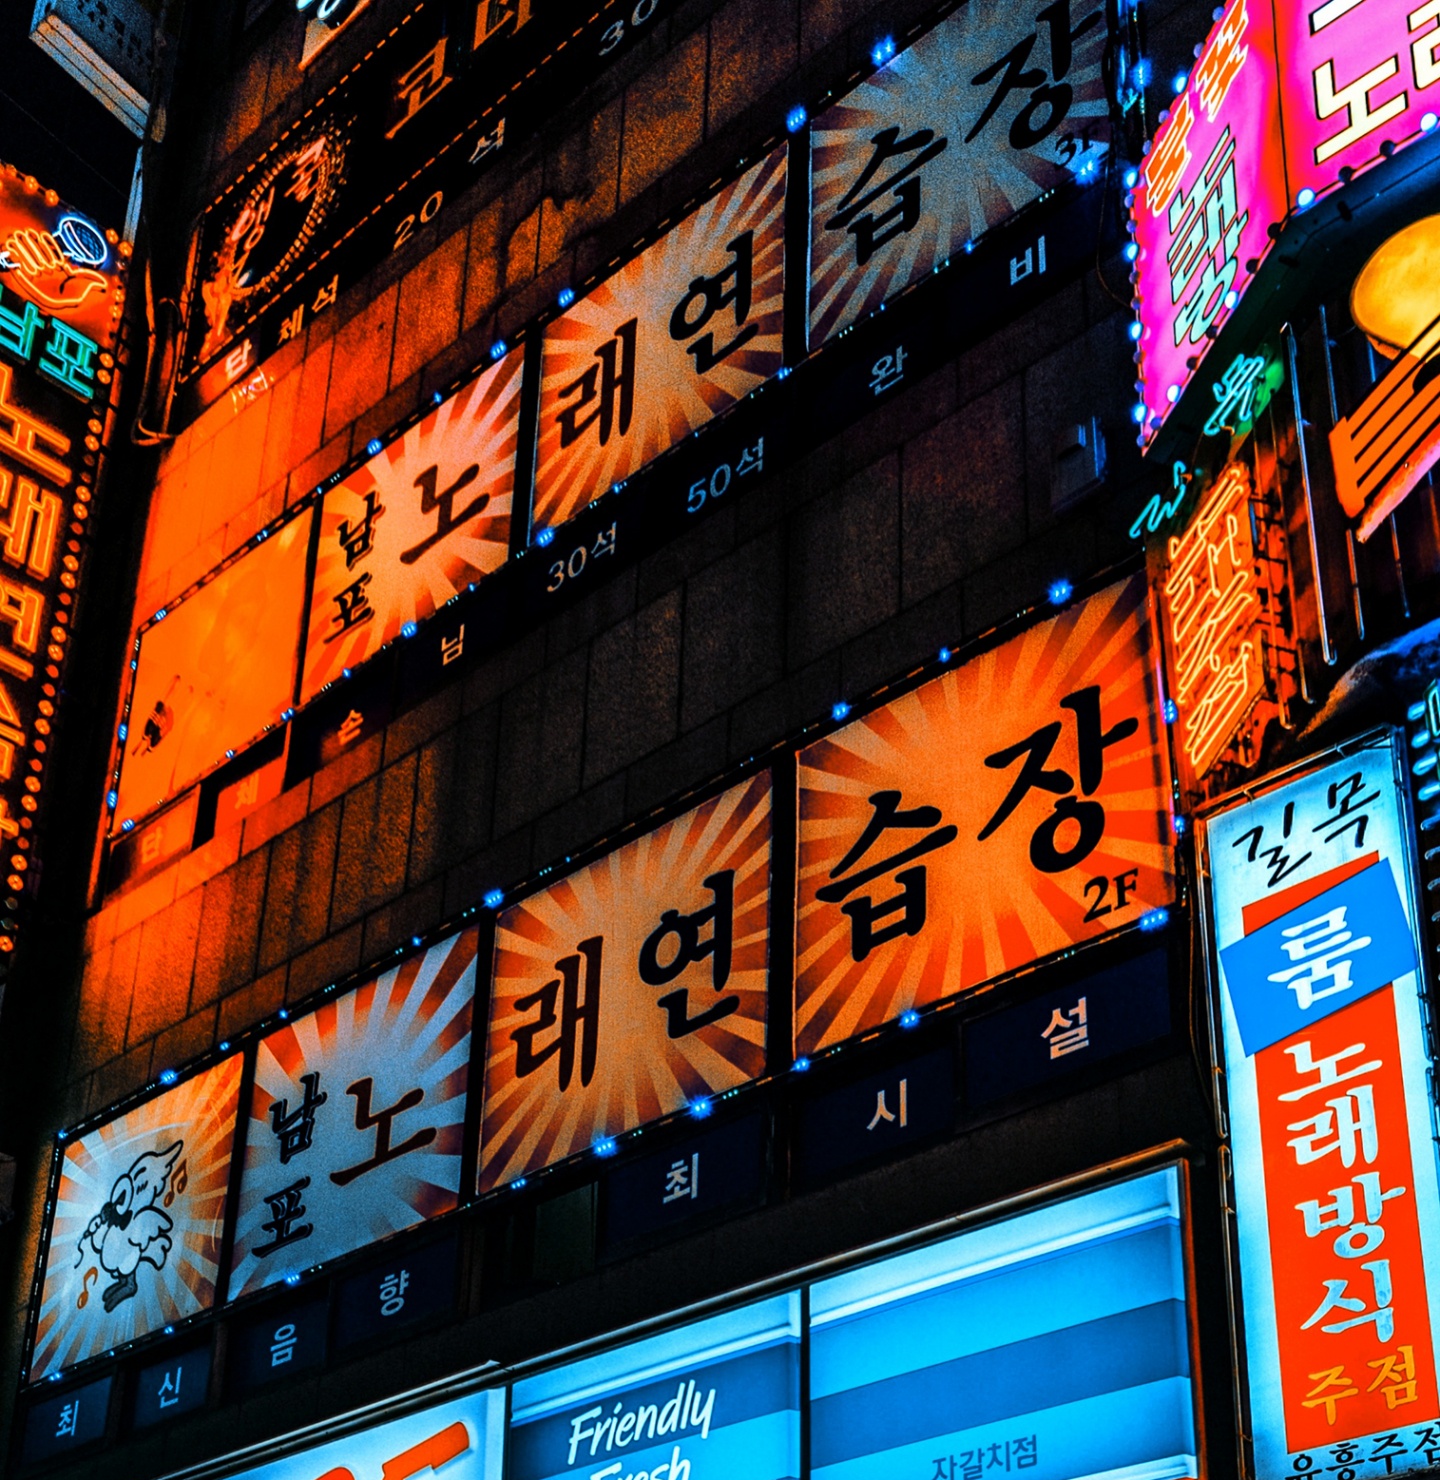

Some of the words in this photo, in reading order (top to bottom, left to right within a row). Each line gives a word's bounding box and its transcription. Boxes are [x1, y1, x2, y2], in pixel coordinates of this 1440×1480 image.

[1168, 124, 1249, 347] 노래방
[687, 436, 766, 514] 50석
[324, 490, 386, 645] 남포
[1231, 771, 1381, 889] 길목
[1082, 868, 1140, 923] 2F
[1266, 905, 1372, 1011] 룸
[251, 1070, 328, 1259] 남포
[1277, 1040, 1406, 1343] 노래방식
[567, 1379, 717, 1466] Friendly
[1301, 1345, 1419, 1427] 주점
